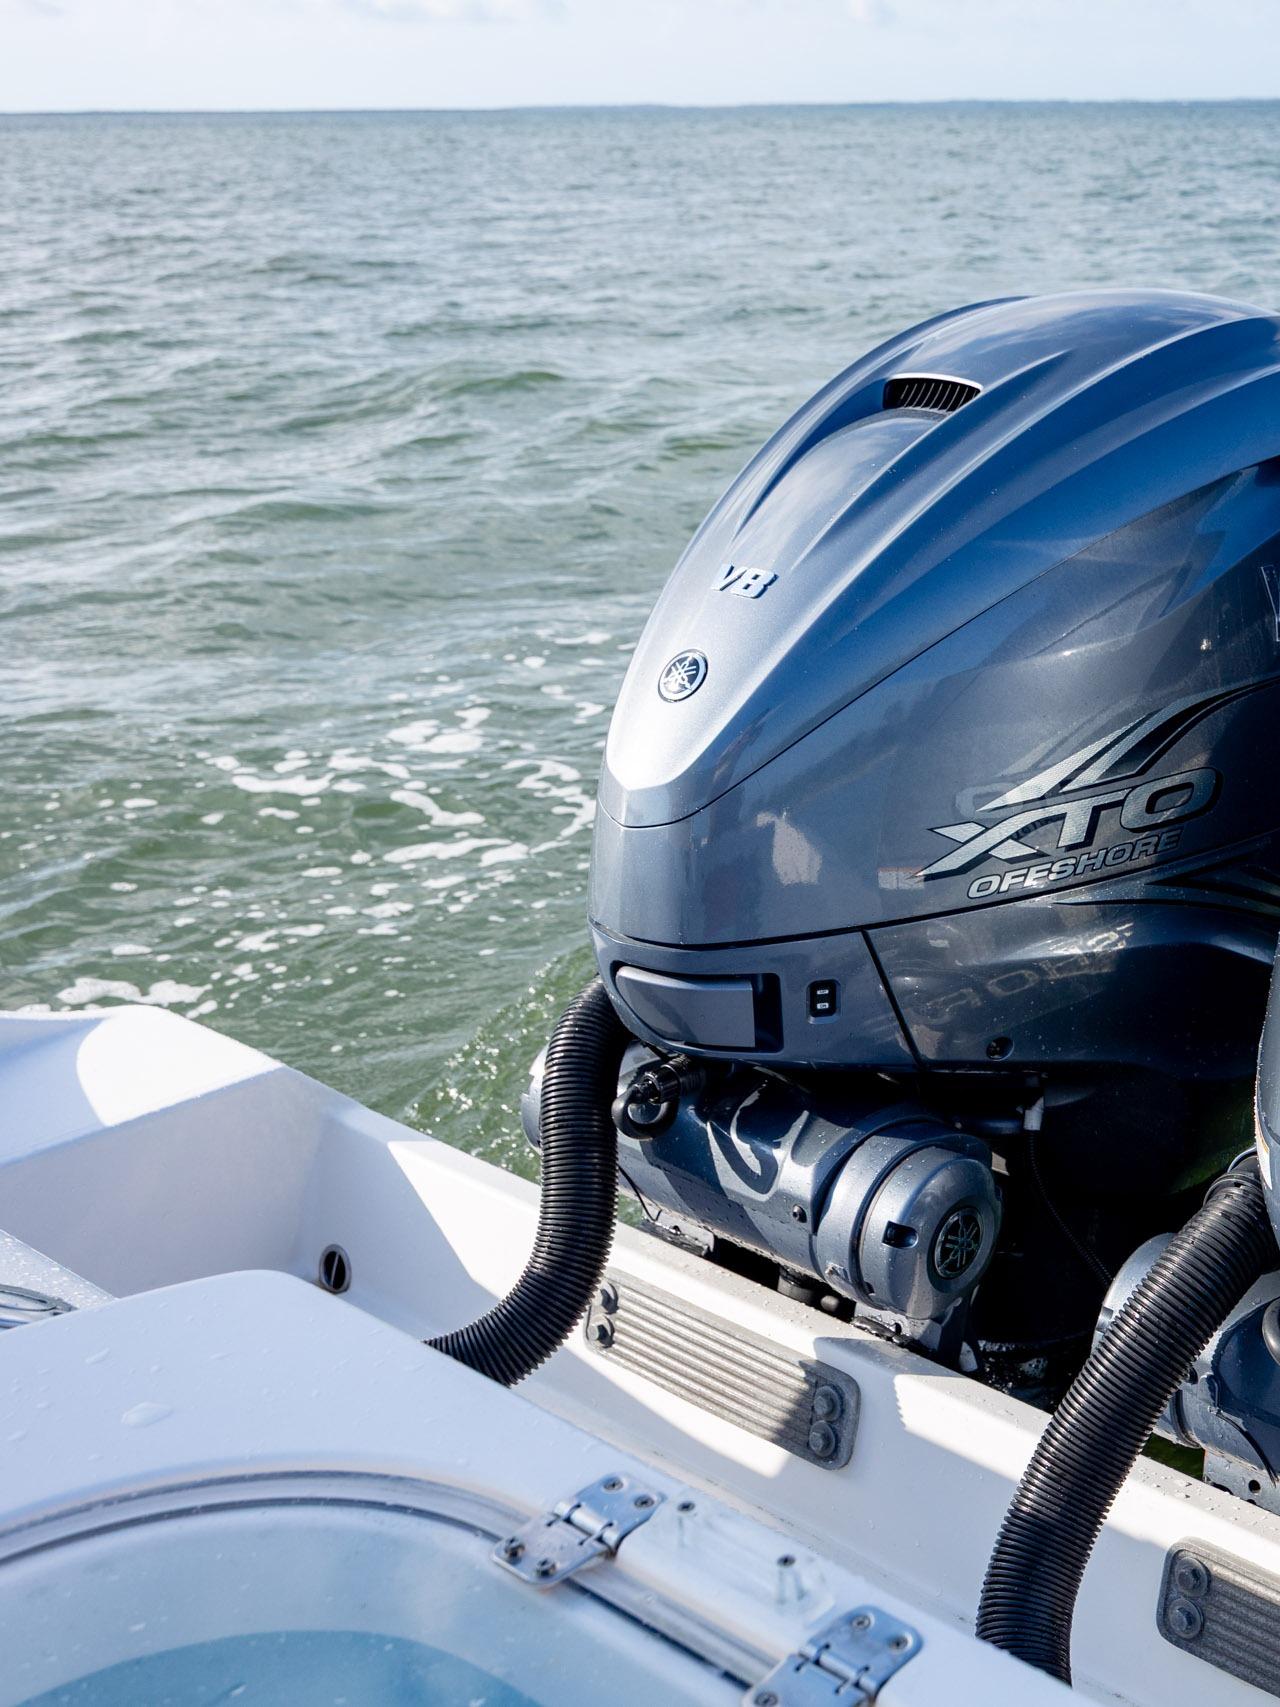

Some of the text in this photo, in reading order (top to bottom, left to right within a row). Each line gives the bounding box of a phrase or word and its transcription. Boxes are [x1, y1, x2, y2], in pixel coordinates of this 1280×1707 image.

[711, 564, 778, 599] V8
[912, 766, 1224, 881] XTO
[966, 828, 1184, 900] OFFSHORE
